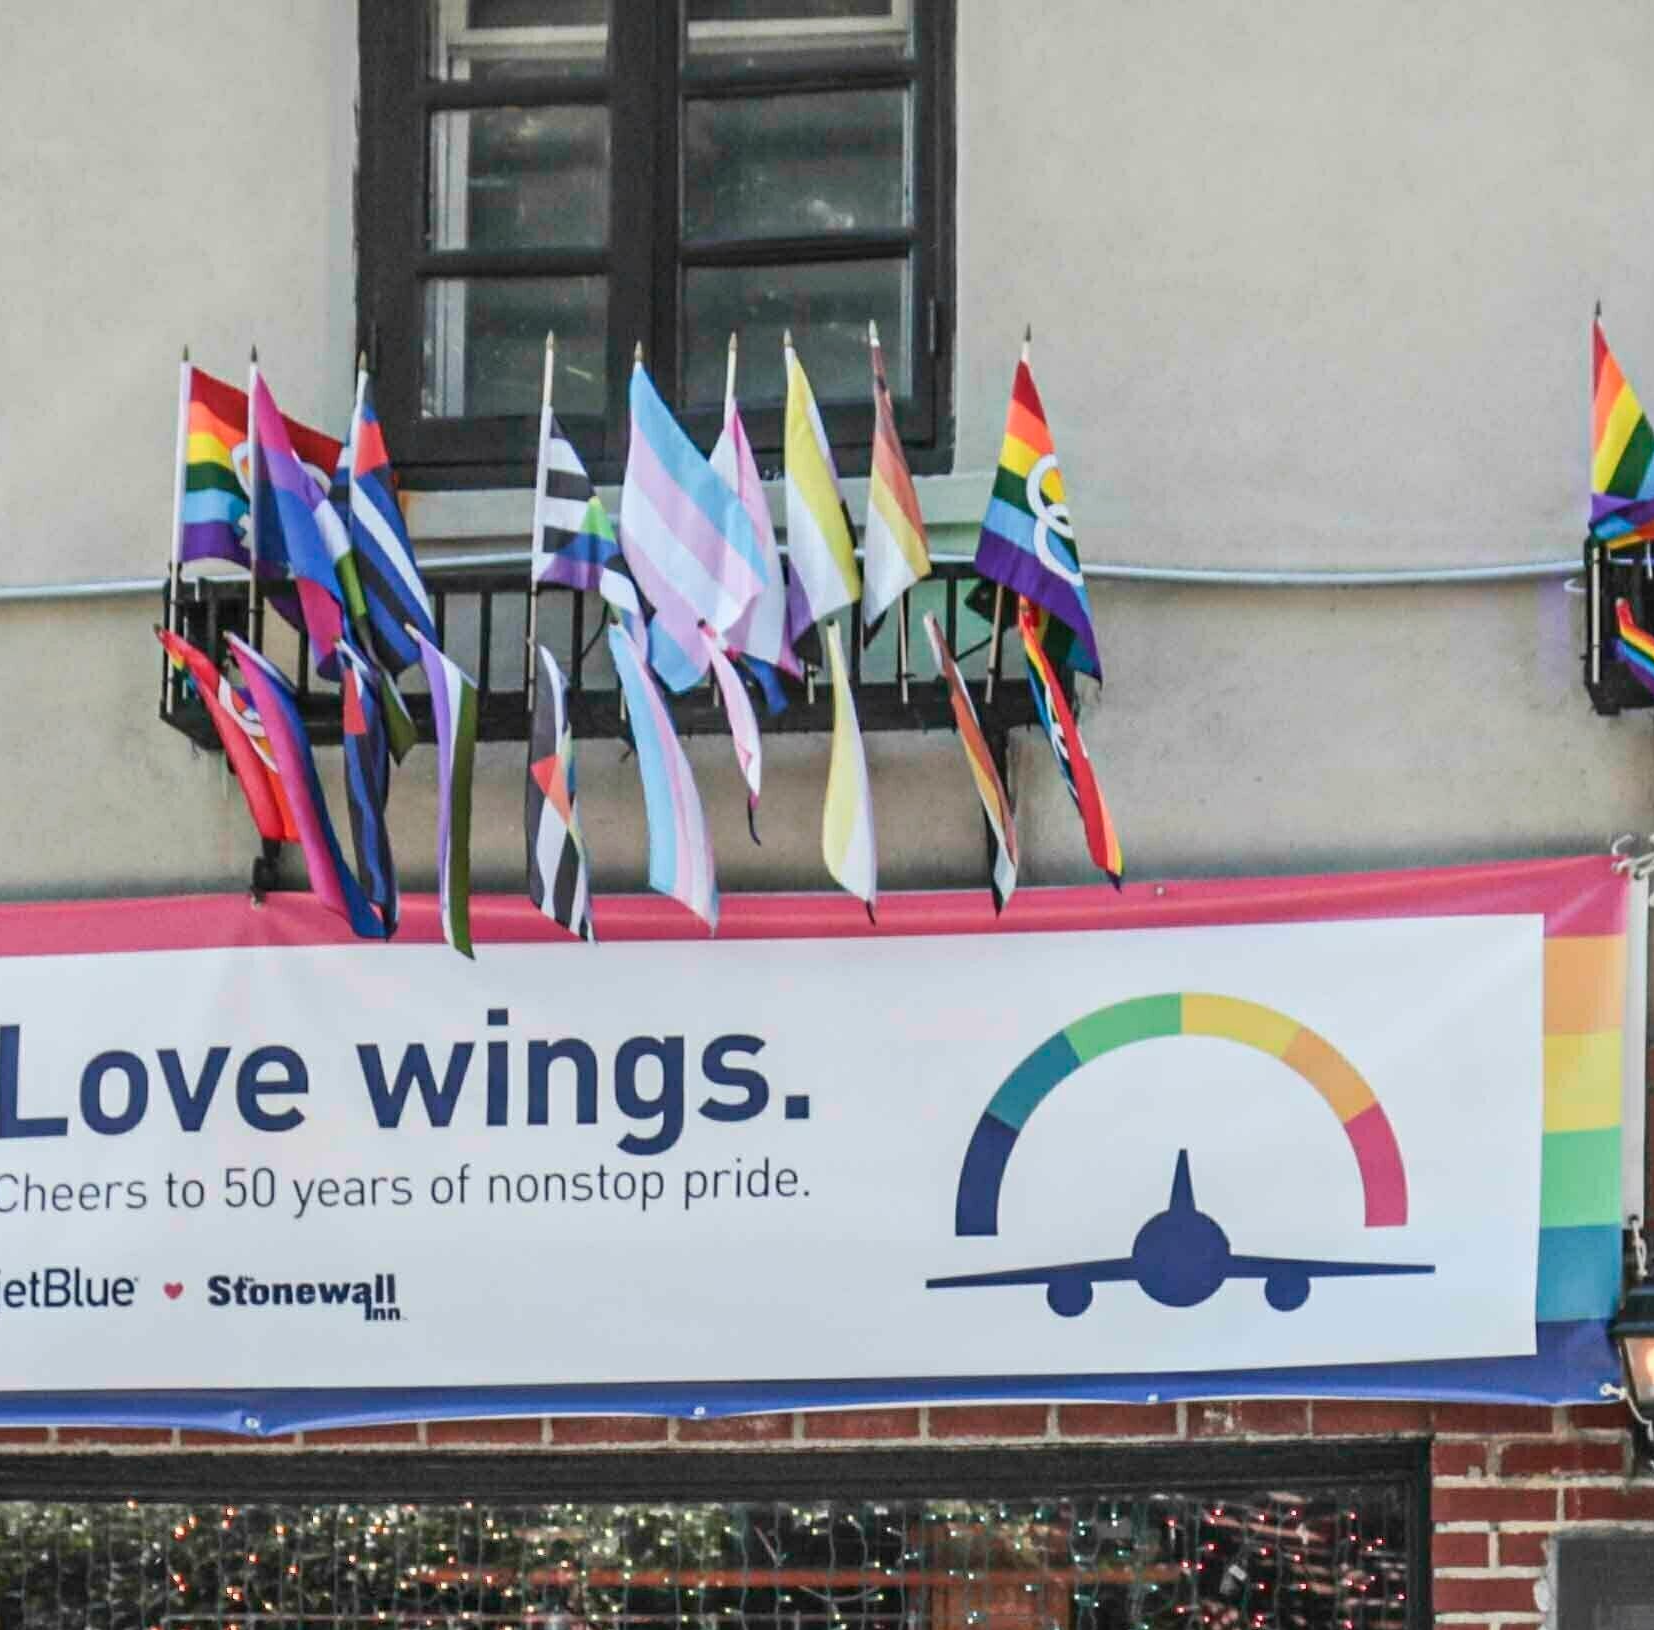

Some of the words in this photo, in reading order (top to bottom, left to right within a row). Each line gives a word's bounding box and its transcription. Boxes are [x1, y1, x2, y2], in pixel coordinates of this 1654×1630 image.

[356, 1008, 810, 1156] wings.
[165, 1172, 205, 1208] to
[224, 1168, 276, 1207] 50
[293, 1176, 413, 1219] years
[430, 1163, 470, 1204] of
[489, 1164, 664, 1212] nonstop
[684, 1157, 810, 1211] pride.
[207, 1273, 395, 1307] Stonewall
[364, 1302, 403, 1322] Inn
